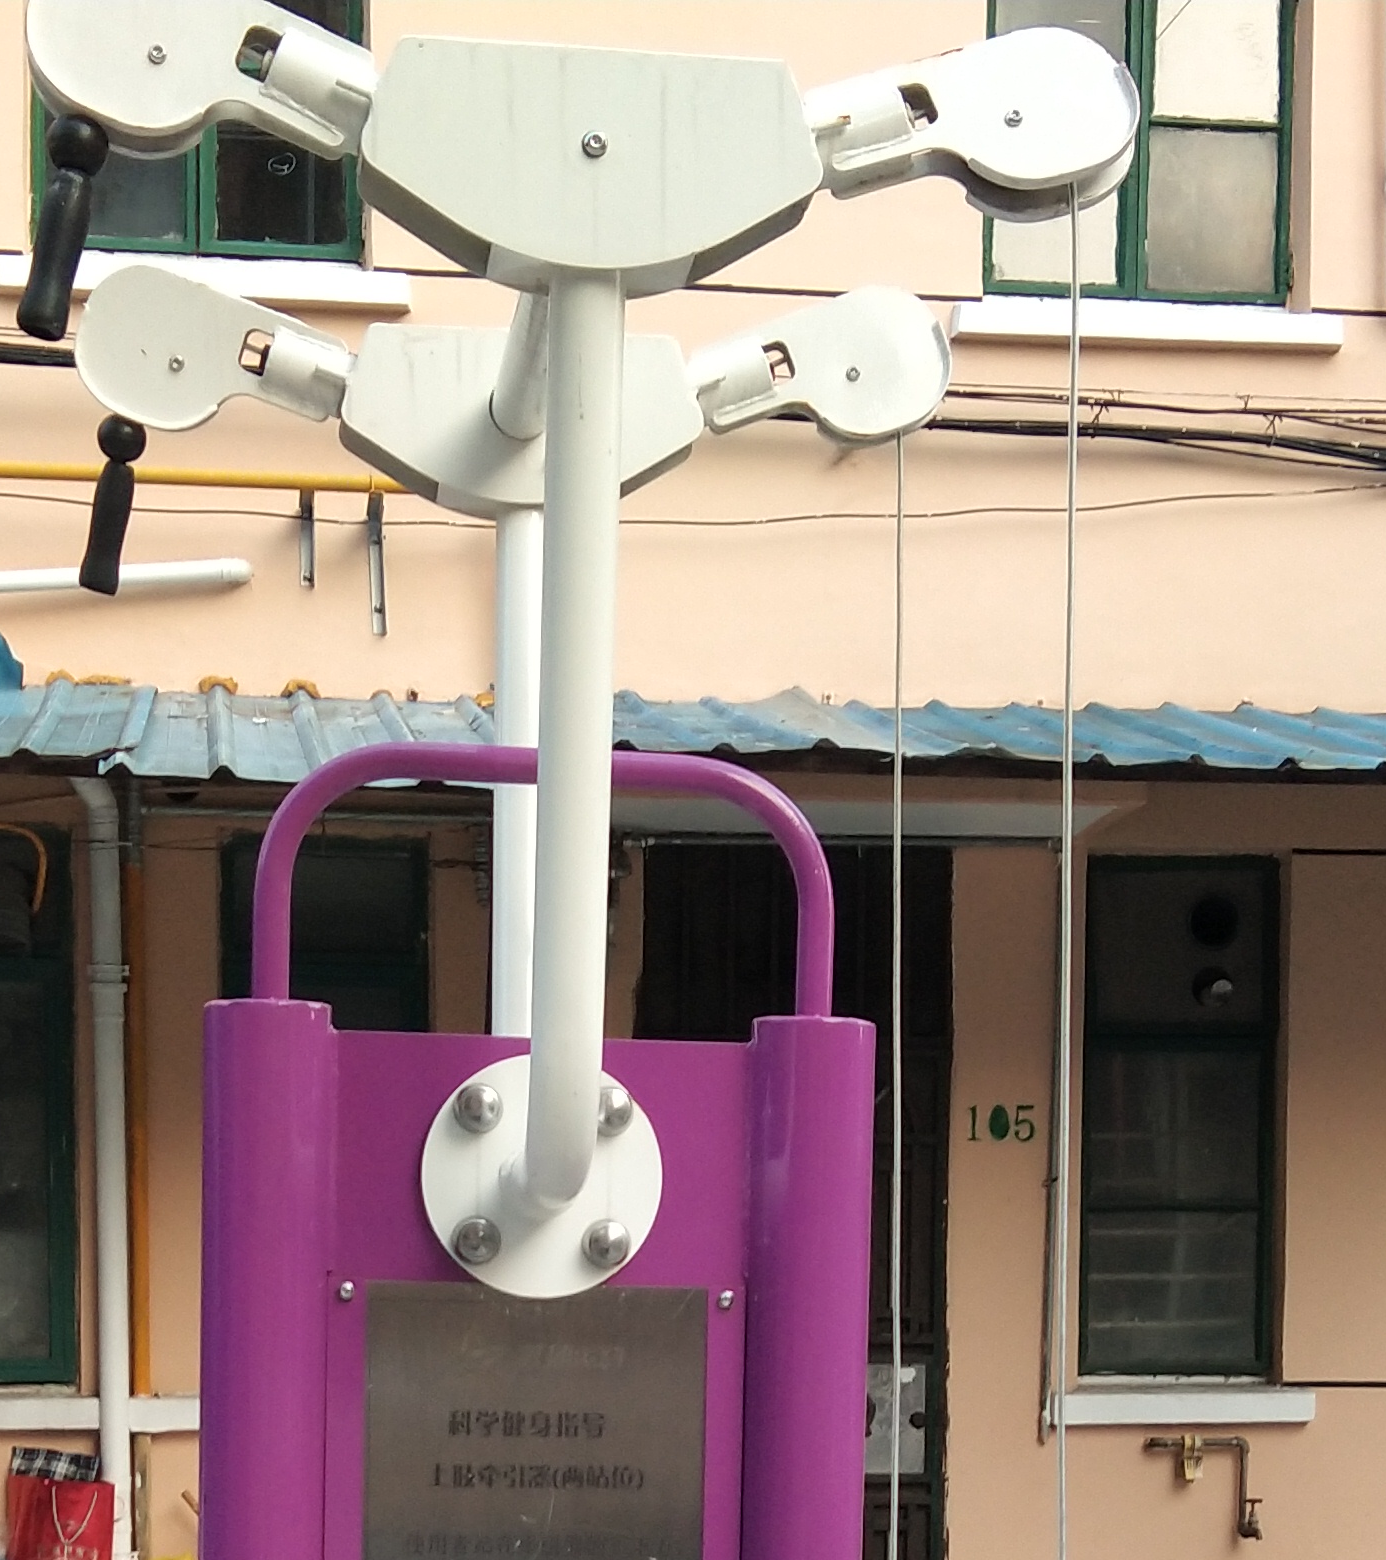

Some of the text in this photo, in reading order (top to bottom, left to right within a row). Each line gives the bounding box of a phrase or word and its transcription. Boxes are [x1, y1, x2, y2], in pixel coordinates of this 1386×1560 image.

[967, 1104, 1035, 1142] 105
[447, 1409, 605, 1439] 科学健身指导
